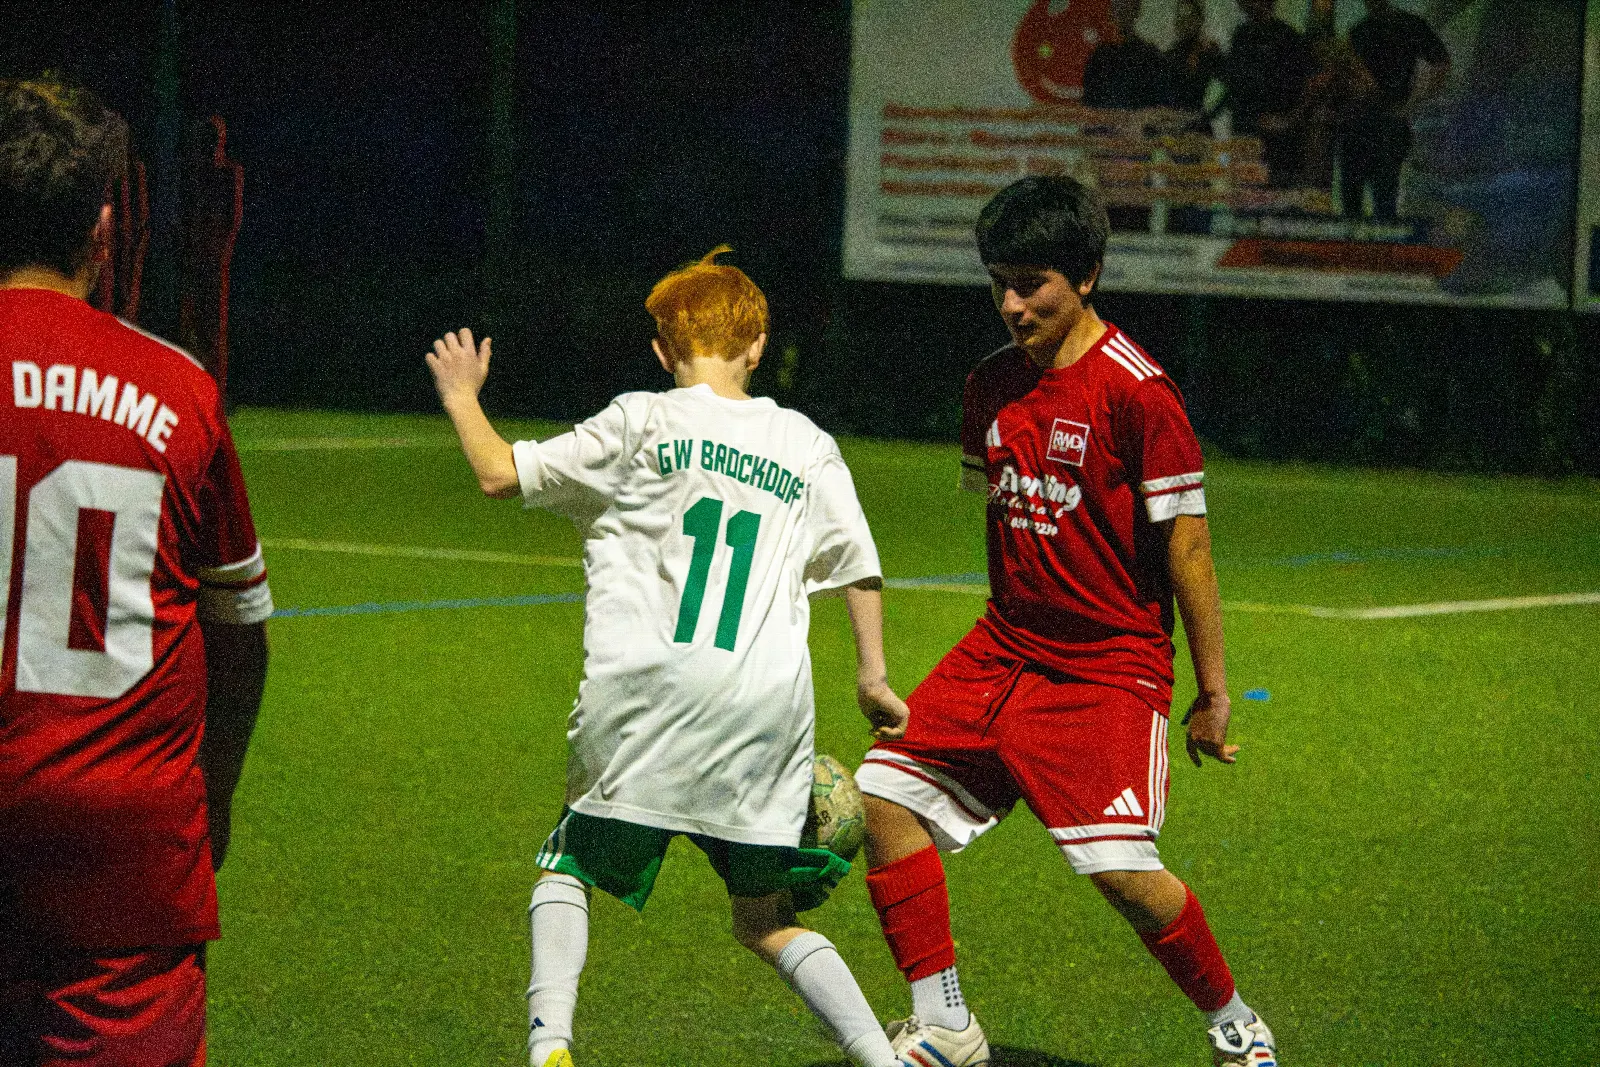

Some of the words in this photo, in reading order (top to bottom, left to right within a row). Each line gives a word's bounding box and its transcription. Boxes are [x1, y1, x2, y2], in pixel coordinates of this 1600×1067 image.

[12, 361, 179, 453] DAMME
[657, 439, 694, 476] GW
[673, 496, 762, 653] 11
